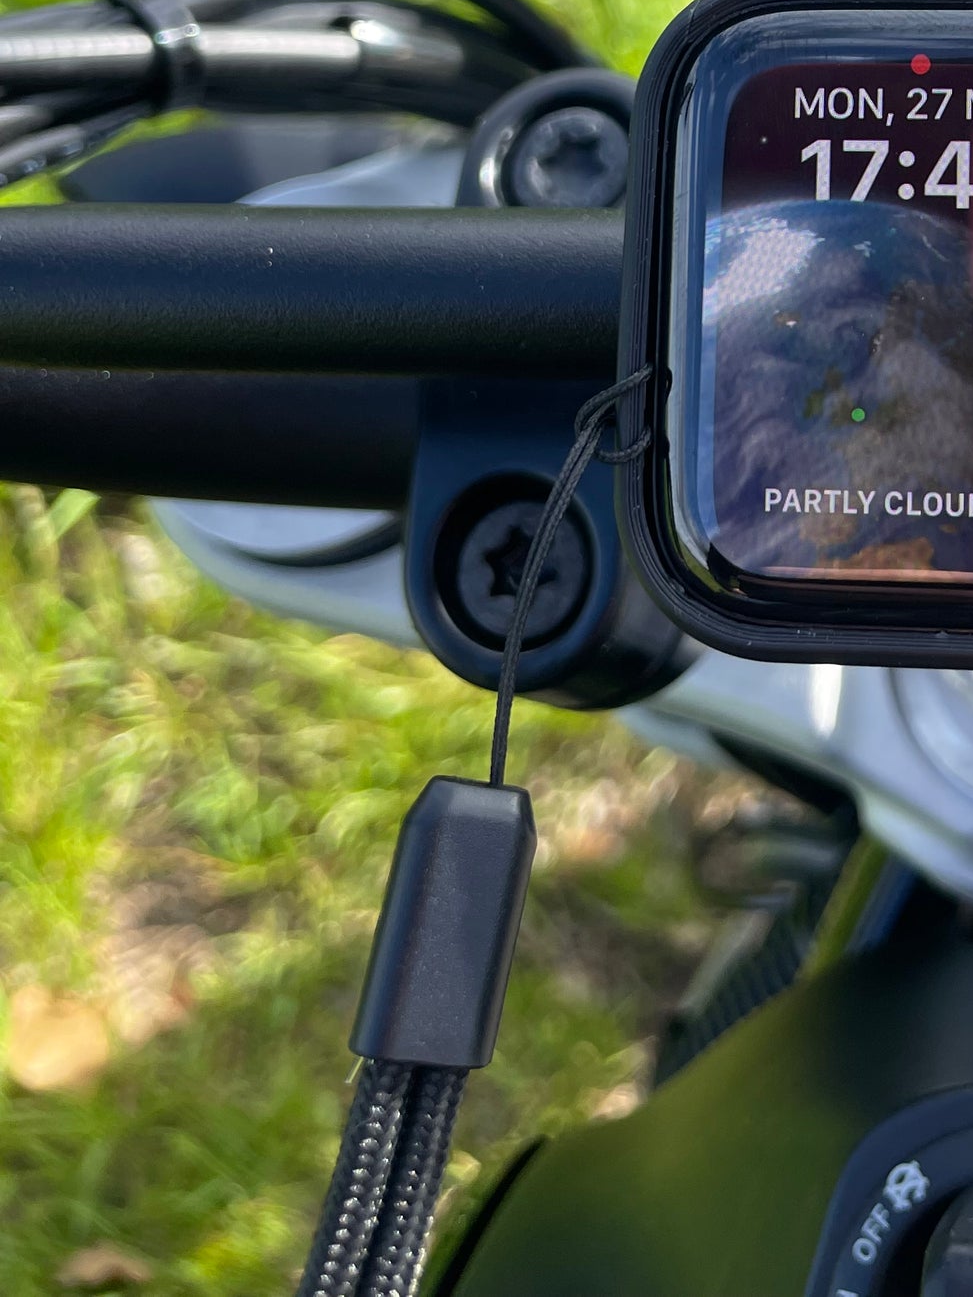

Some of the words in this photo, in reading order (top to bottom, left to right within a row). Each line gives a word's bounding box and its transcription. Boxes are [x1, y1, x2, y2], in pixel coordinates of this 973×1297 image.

[793, 86, 895, 127] MON,
[905, 86, 954, 121] 27
[763, 487, 877, 516] PARTLY
[851, 1202, 890, 1264] OFF
